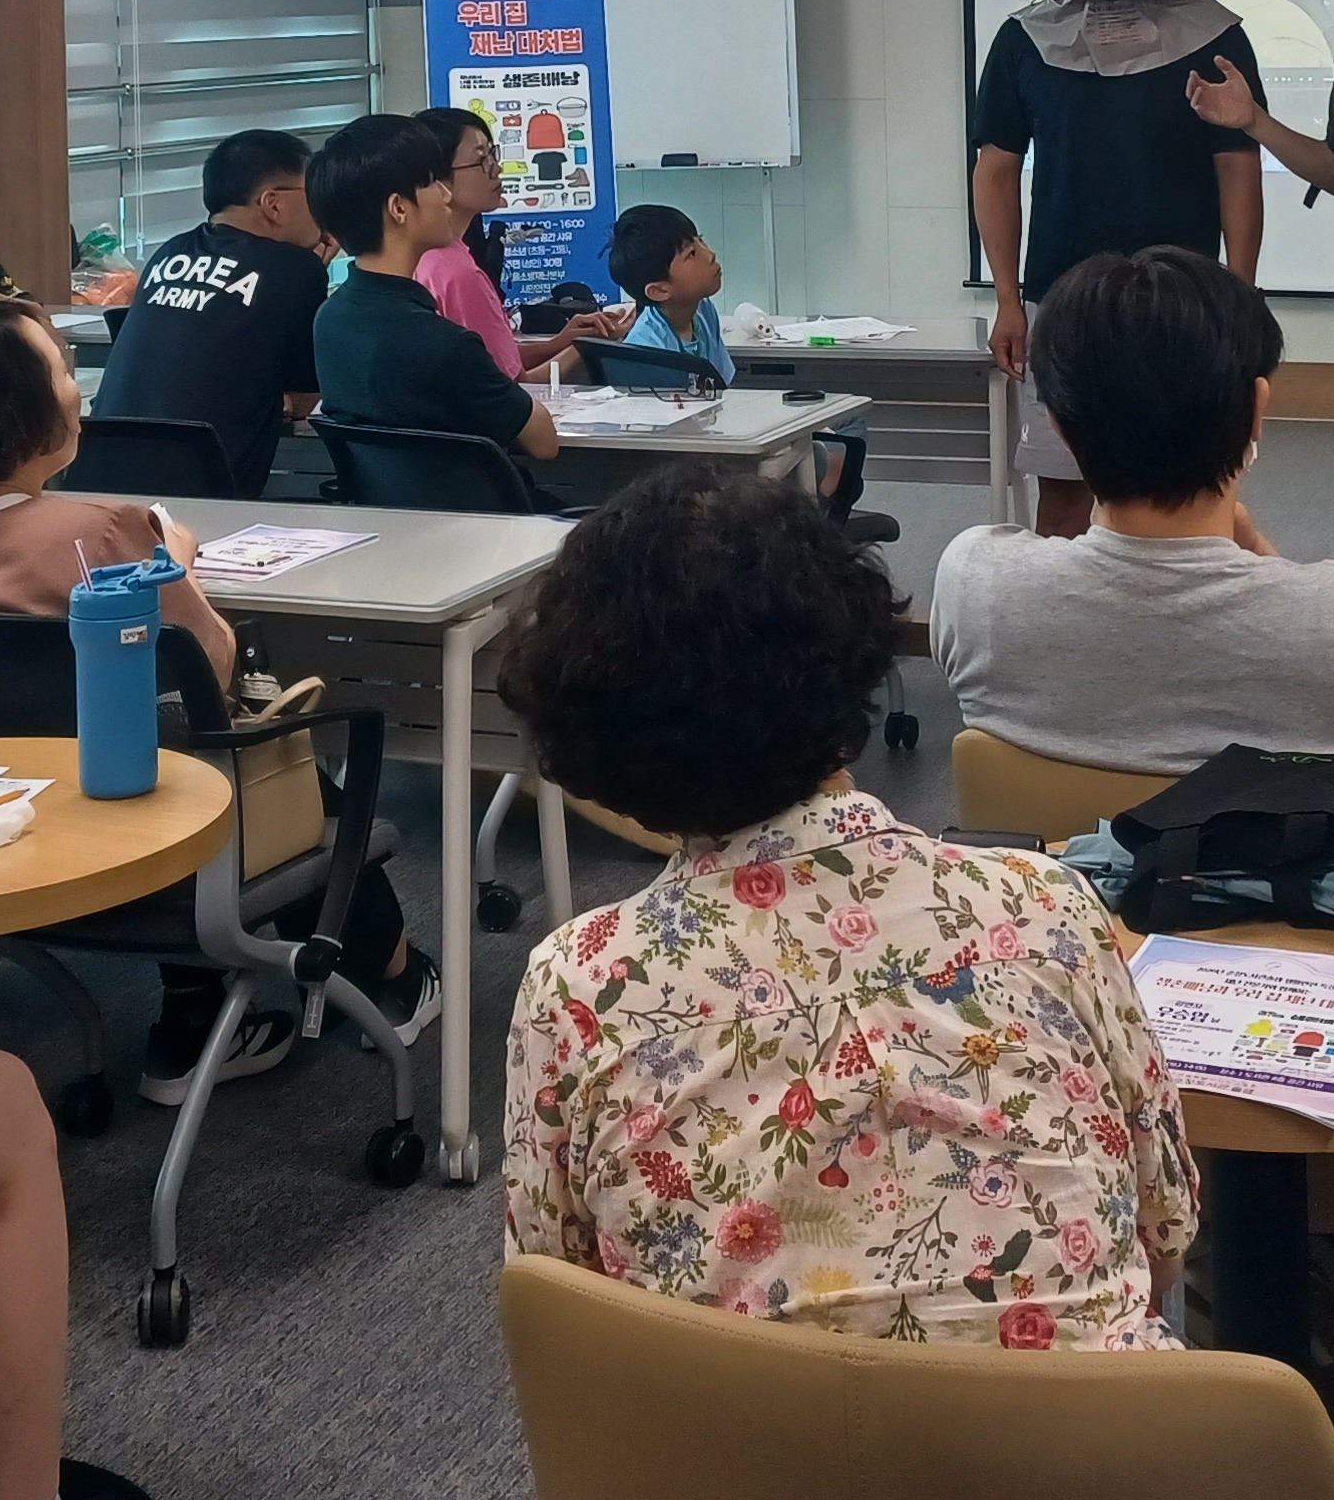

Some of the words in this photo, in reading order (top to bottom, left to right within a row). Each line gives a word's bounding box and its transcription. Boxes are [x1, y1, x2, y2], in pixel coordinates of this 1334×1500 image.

[457, 1, 502, 27] 우리
[504, 0, 527, 26] 집
[469, 31, 514, 56] 재난
[516, 28, 583, 55] 대처법
[560, 219, 585, 229] 16:00
[143, 254, 260, 307] KOREA
[147, 285, 216, 312] ARMY
[1233, 986, 1263, 1001] 우리
